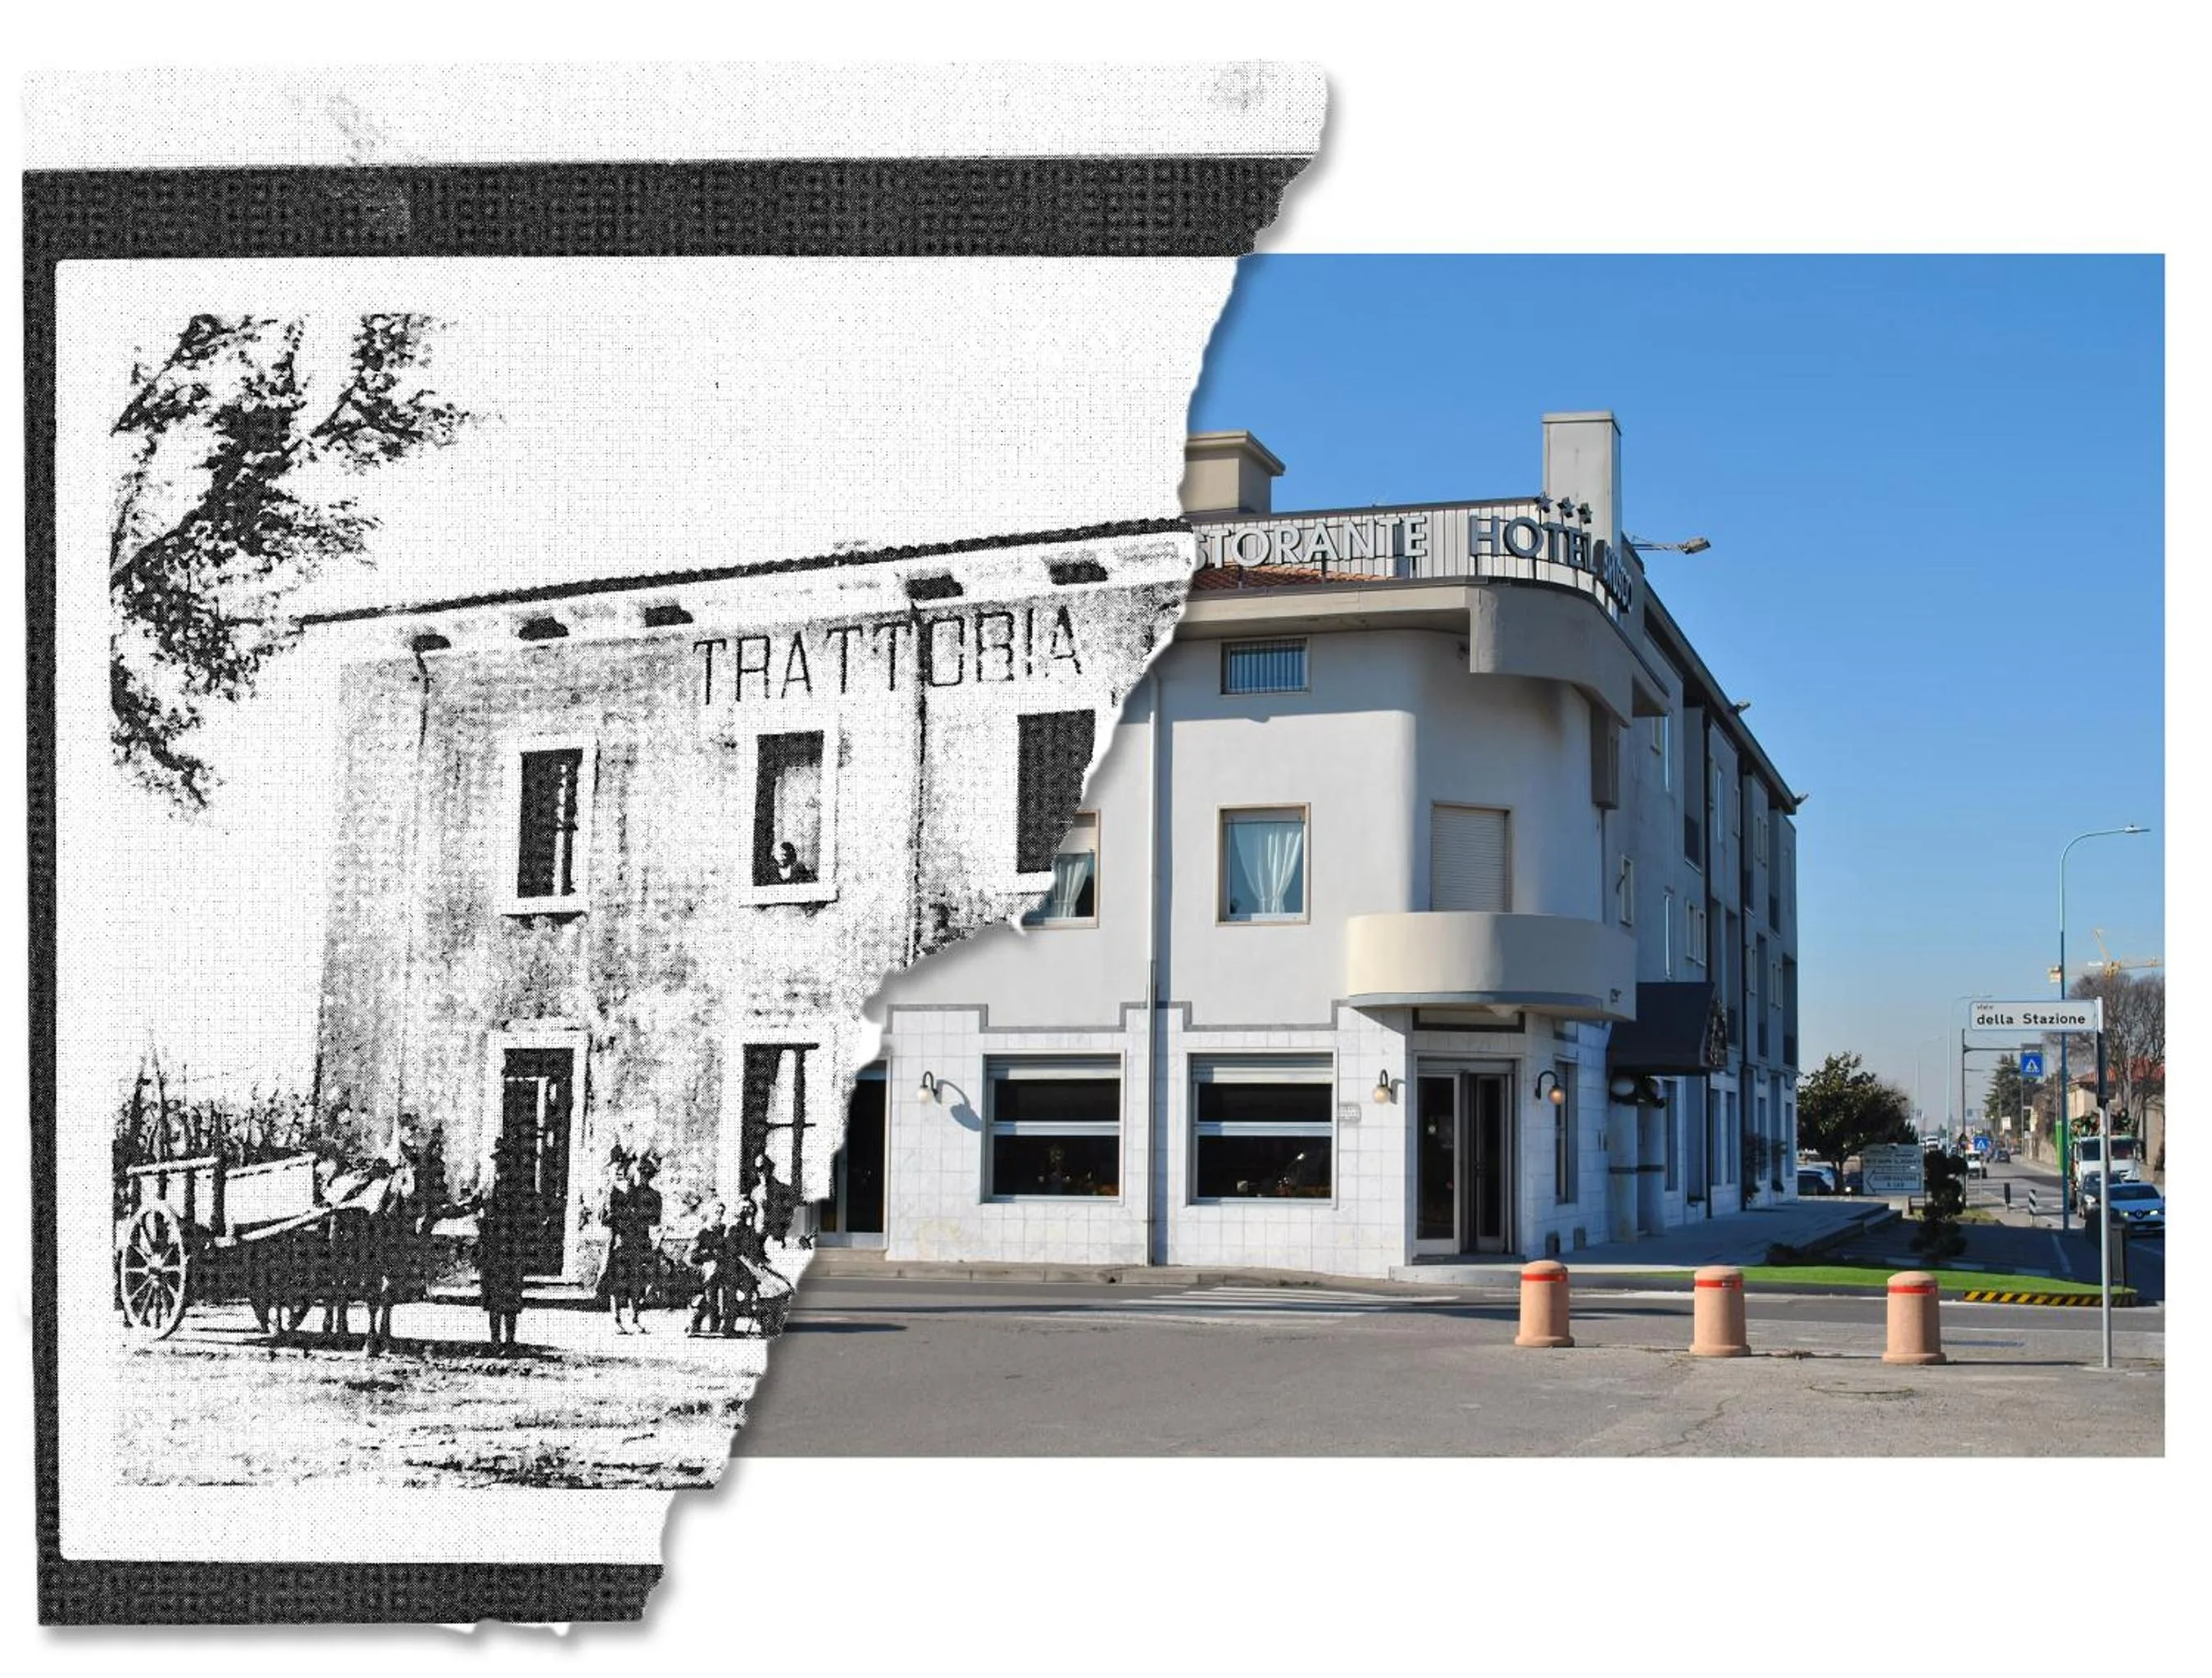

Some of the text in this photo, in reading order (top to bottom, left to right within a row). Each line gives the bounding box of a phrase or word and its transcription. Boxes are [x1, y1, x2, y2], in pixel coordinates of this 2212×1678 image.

[1468, 514, 1598, 574] HOTEL
[693, 605, 1083, 705] TRATTORIA
[1976, 1012, 2087, 1026] della Stazione
